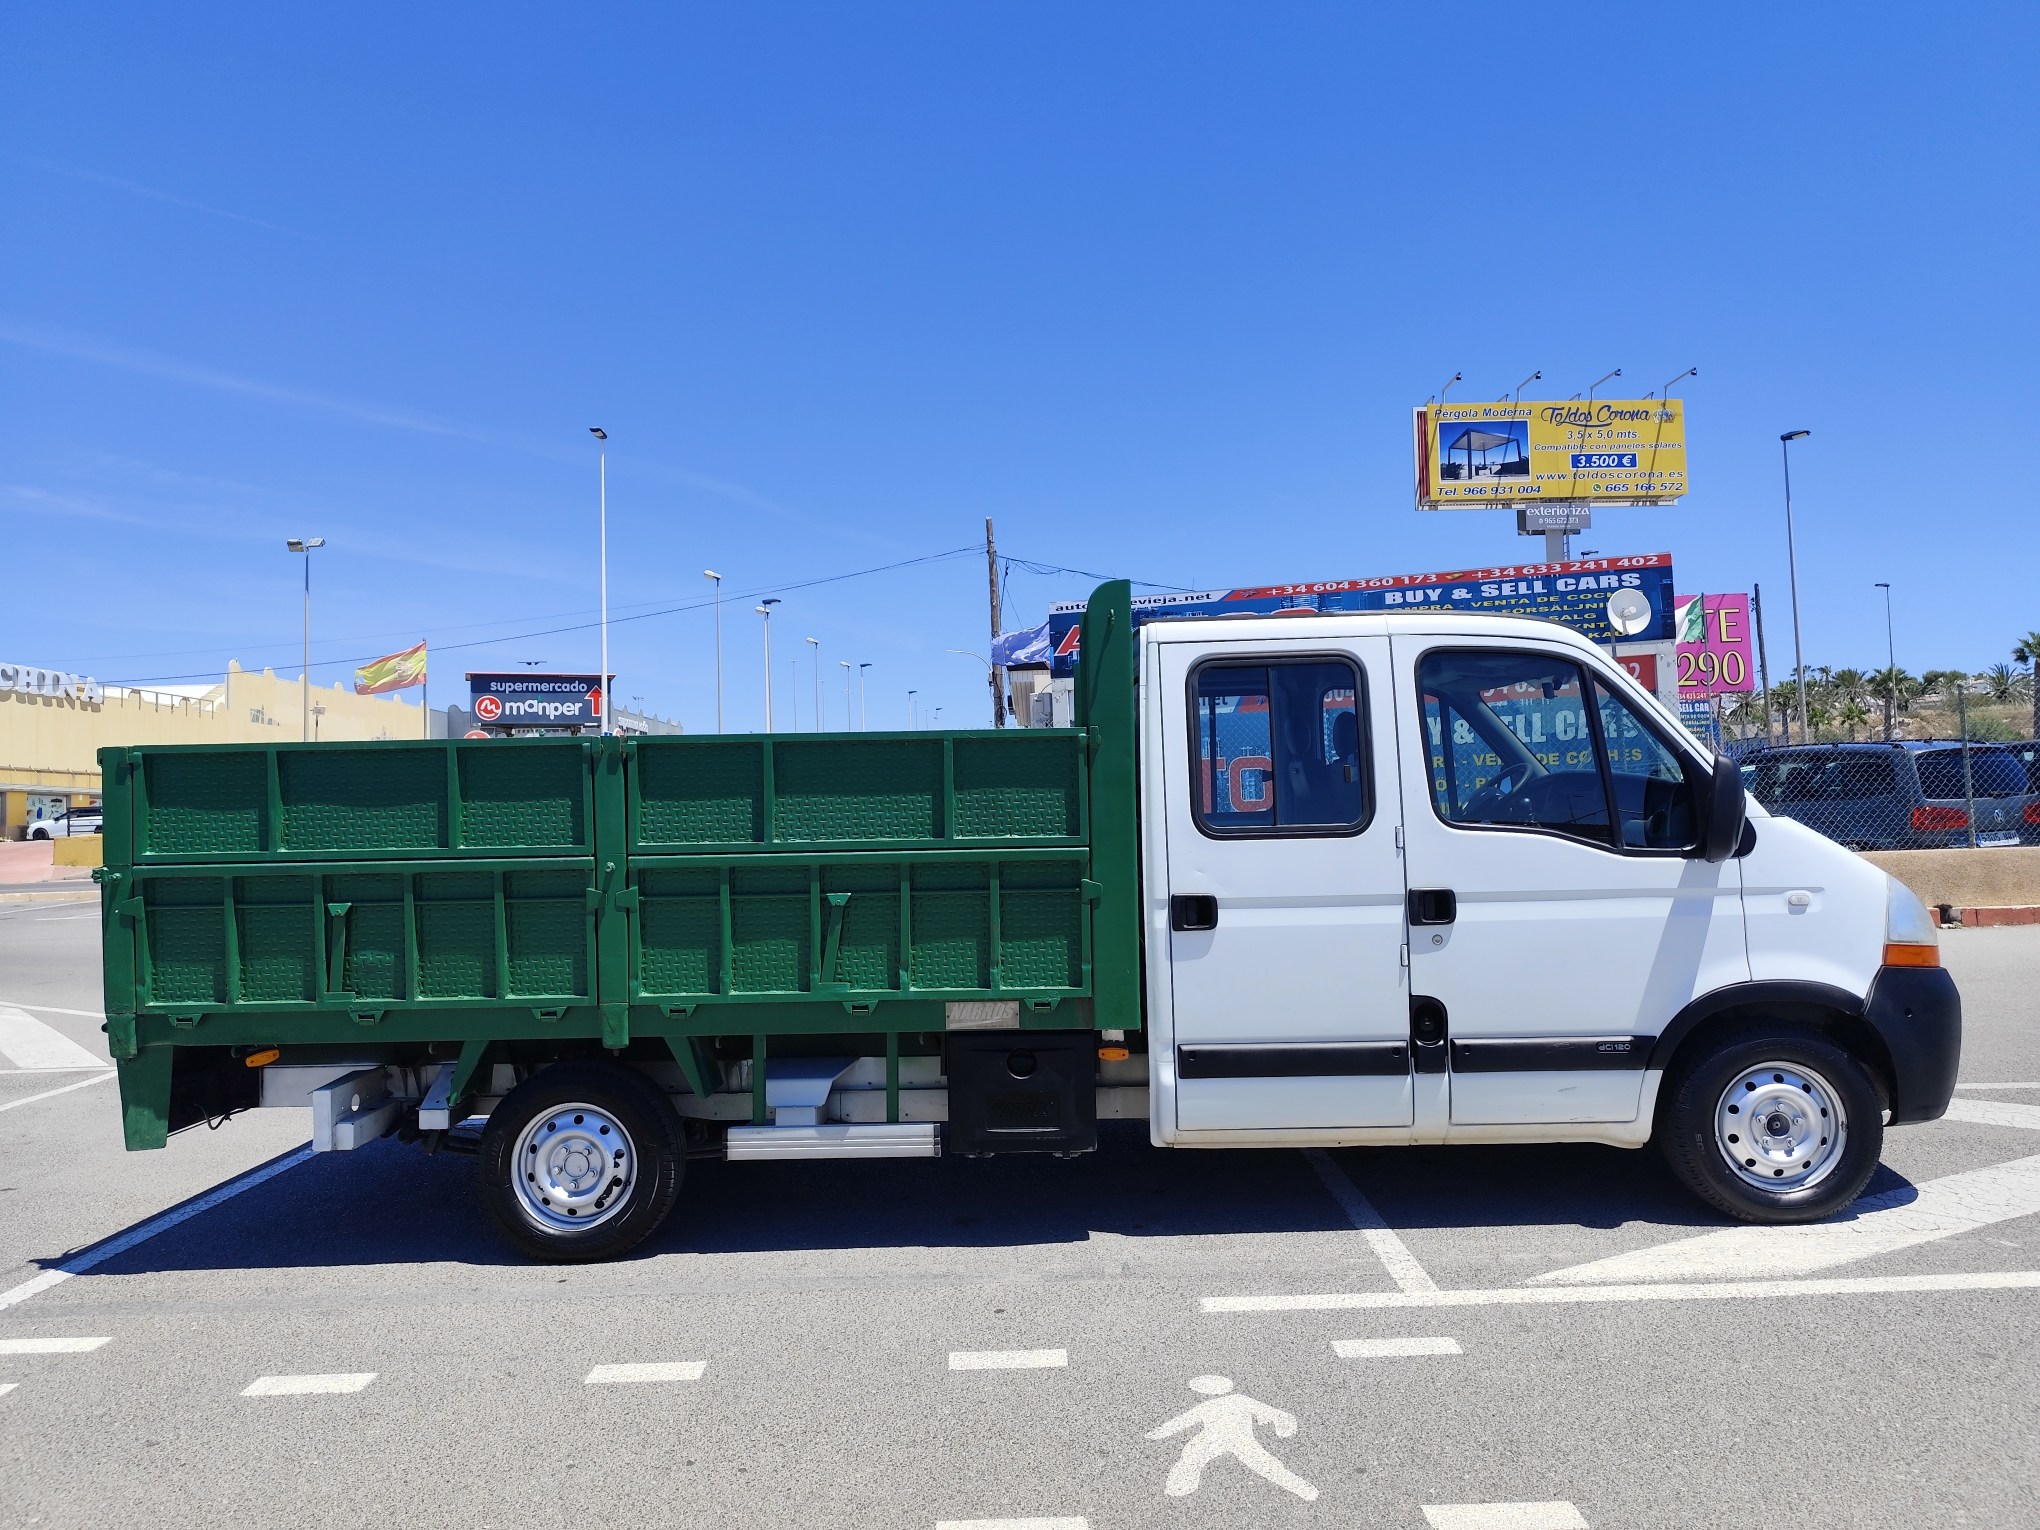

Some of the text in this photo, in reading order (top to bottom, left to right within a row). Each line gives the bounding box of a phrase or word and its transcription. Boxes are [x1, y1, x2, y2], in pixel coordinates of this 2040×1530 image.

[1434, 408, 1532, 419] Pérgola Moderna
[1541, 404, 1650, 426] Toldos Corona
[1567, 430, 1584, 440] 3,5
[1597, 430, 1613, 440] 5,0
[1616, 430, 1640, 439] mts.
[1534, 443, 1587, 451] Compatible
[1577, 455, 1632, 467] 3.500 €
[1536, 470, 1683, 480] www.toldoscorona.es
[1437, 485, 1541, 496] Tel. 966 931 004
[1605, 482, 1683, 492] 665 166 572
[1526, 505, 1590, 516] exterioriza
[1472, 556, 1659, 578] +34 633 241 402
[1267, 574, 1437, 595] +34 604 360 173
[1384, 573, 1641, 605] BUY & SELL CARS
[1471, 597, 1530, 608] VENTA
[1537, 595, 1560, 603] DE
[1677, 650, 1746, 687] 290
[490, 680, 588, 694] supermercado
[505, 699, 583, 720] manper
